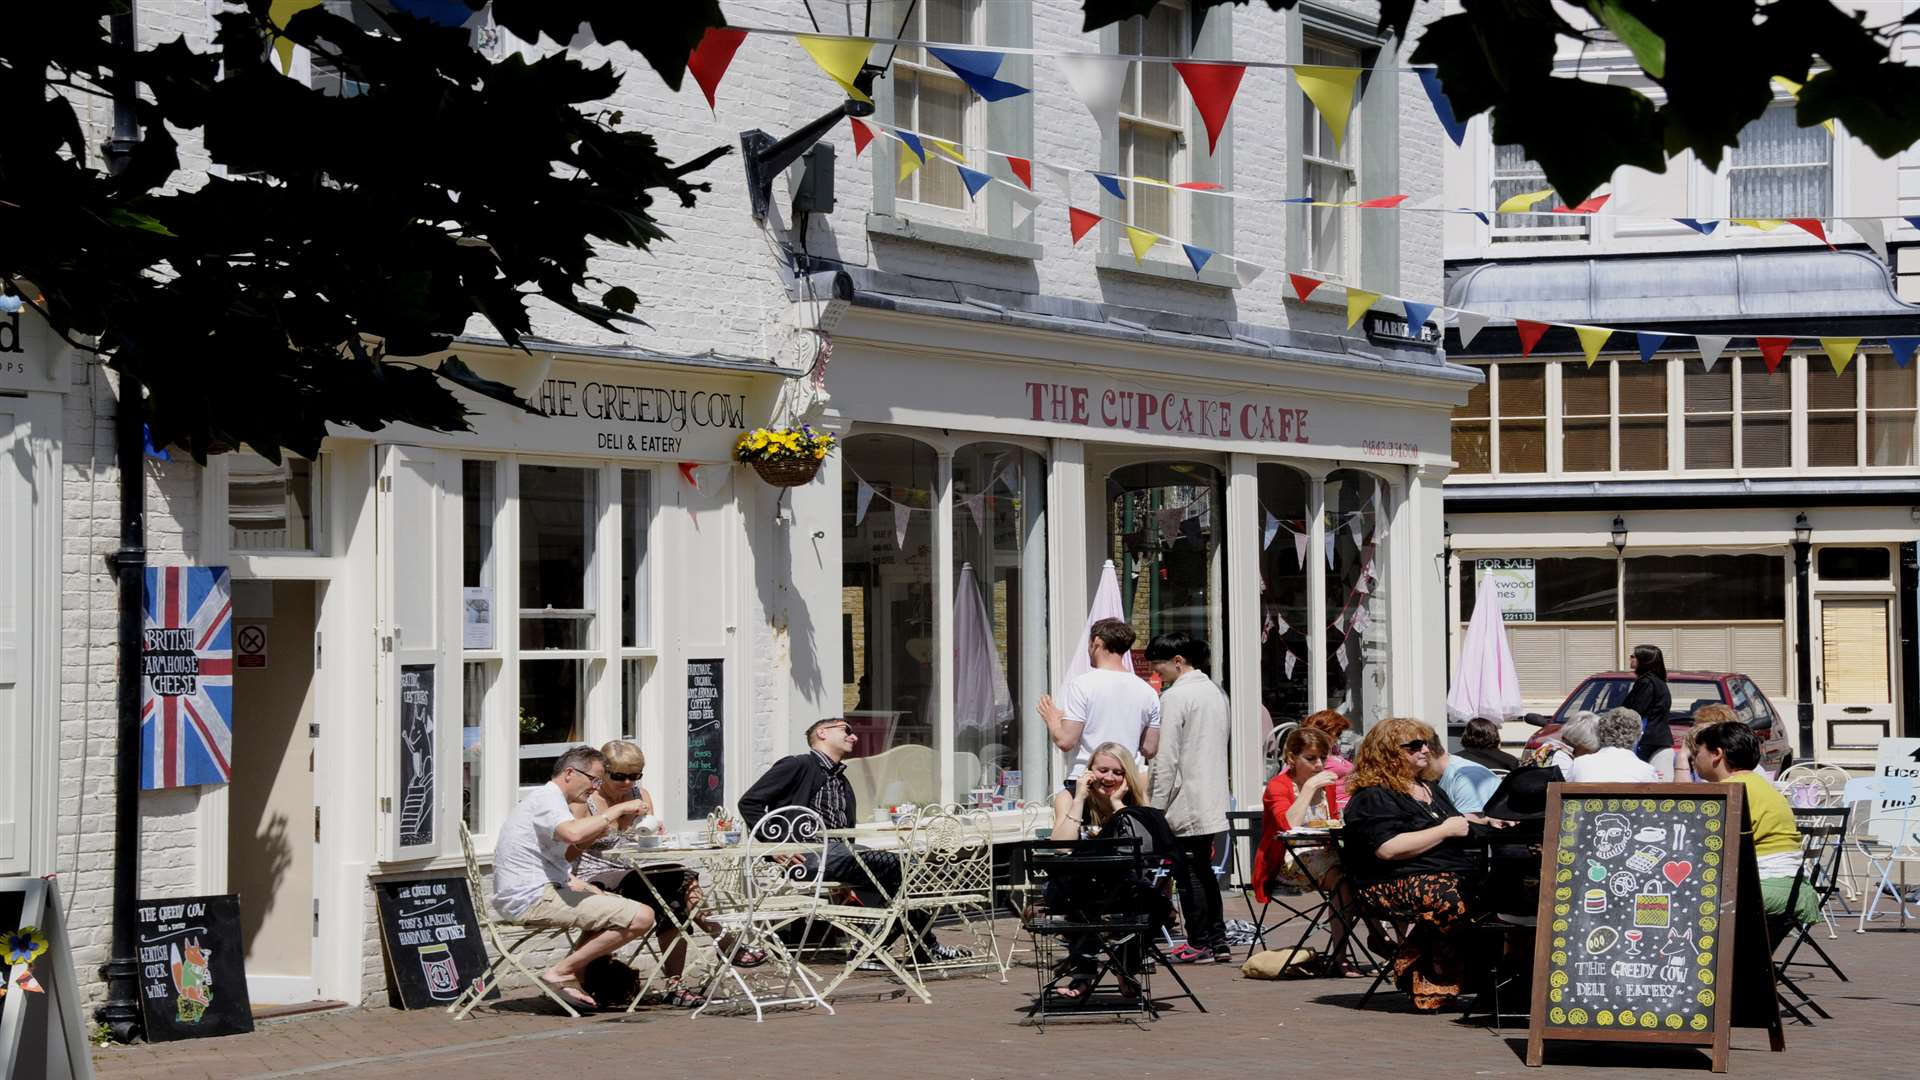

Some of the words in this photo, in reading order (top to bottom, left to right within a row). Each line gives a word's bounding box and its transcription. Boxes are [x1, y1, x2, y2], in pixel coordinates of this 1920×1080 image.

[0, 362, 24, 373] PS
[538, 378, 578, 417] HE
[582, 381, 687, 432] GREEDY
[690, 391, 746, 429] COW
[1025, 382, 1090, 426] THE
[1100, 388, 1232, 438] CUPCAKE
[1239, 402, 1309, 444] CAFE
[598, 432, 623, 450] DELI
[627, 434, 638, 451] &
[641, 435, 682, 453] EATERY
[1478, 559, 1501, 569] FOR
[1504, 559, 1533, 569] SALE
[147, 629, 193, 651] BRITISH
[144, 655, 199, 674] ARMHOUSE
[152, 675, 197, 694] CHEESE
[139, 907, 156, 921] THE
[187, 903, 206, 916] COW
[145, 963, 168, 978] CIDER
[1574, 961, 1607, 976] THE
[1610, 960, 1659, 979] GREEDY
[1660, 964, 1689, 983] COW
[145, 984, 168, 998] WINE
[1576, 982, 1606, 996] DELI
[1625, 983, 1677, 998] EATERY
